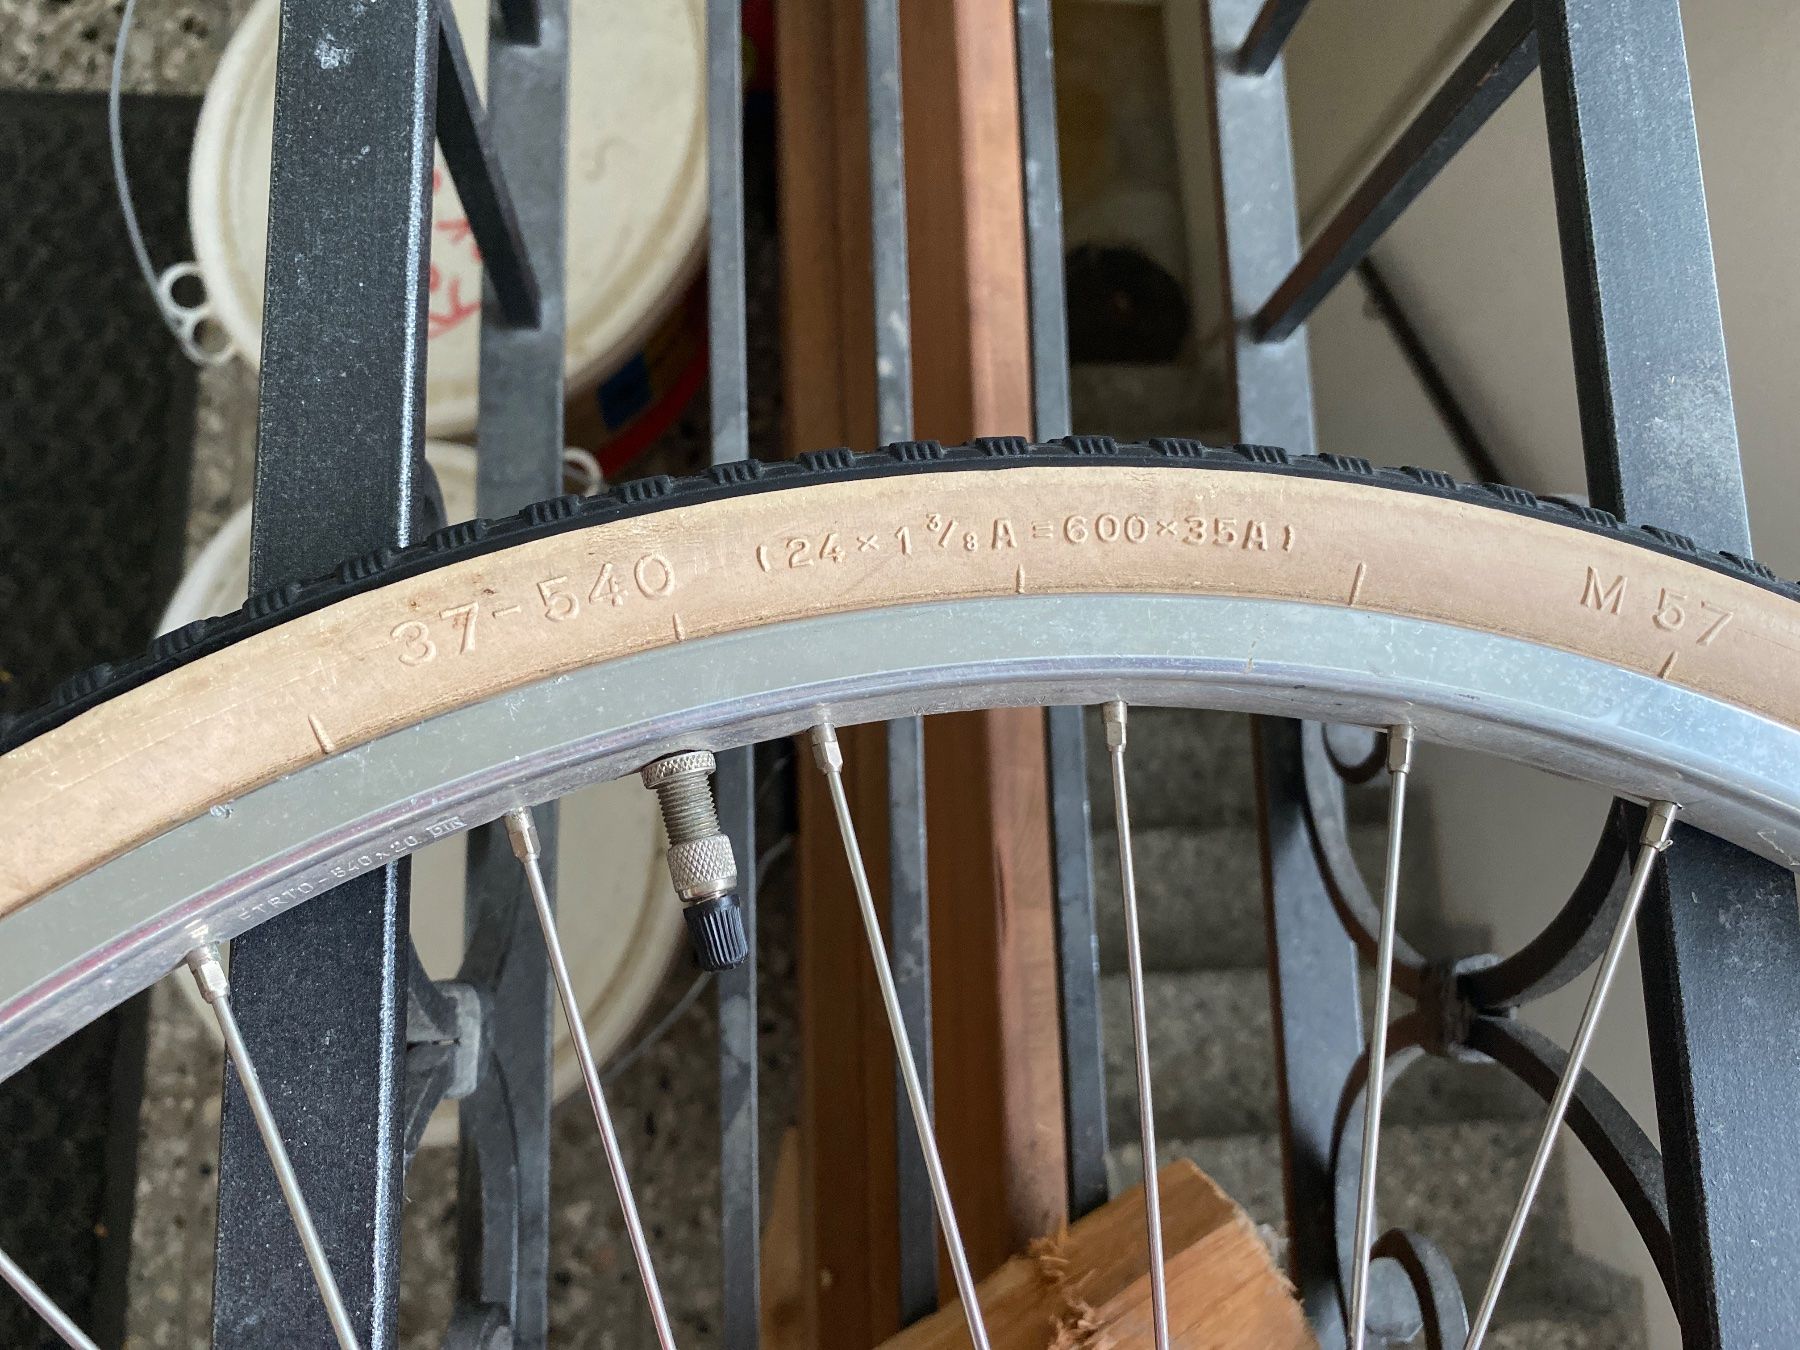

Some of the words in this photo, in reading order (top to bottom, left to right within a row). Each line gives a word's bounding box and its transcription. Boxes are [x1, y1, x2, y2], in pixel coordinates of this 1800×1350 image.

[389, 552, 676, 667] 37-540
[1580, 565, 1629, 616] M
[1651, 587, 1734, 647] 57
